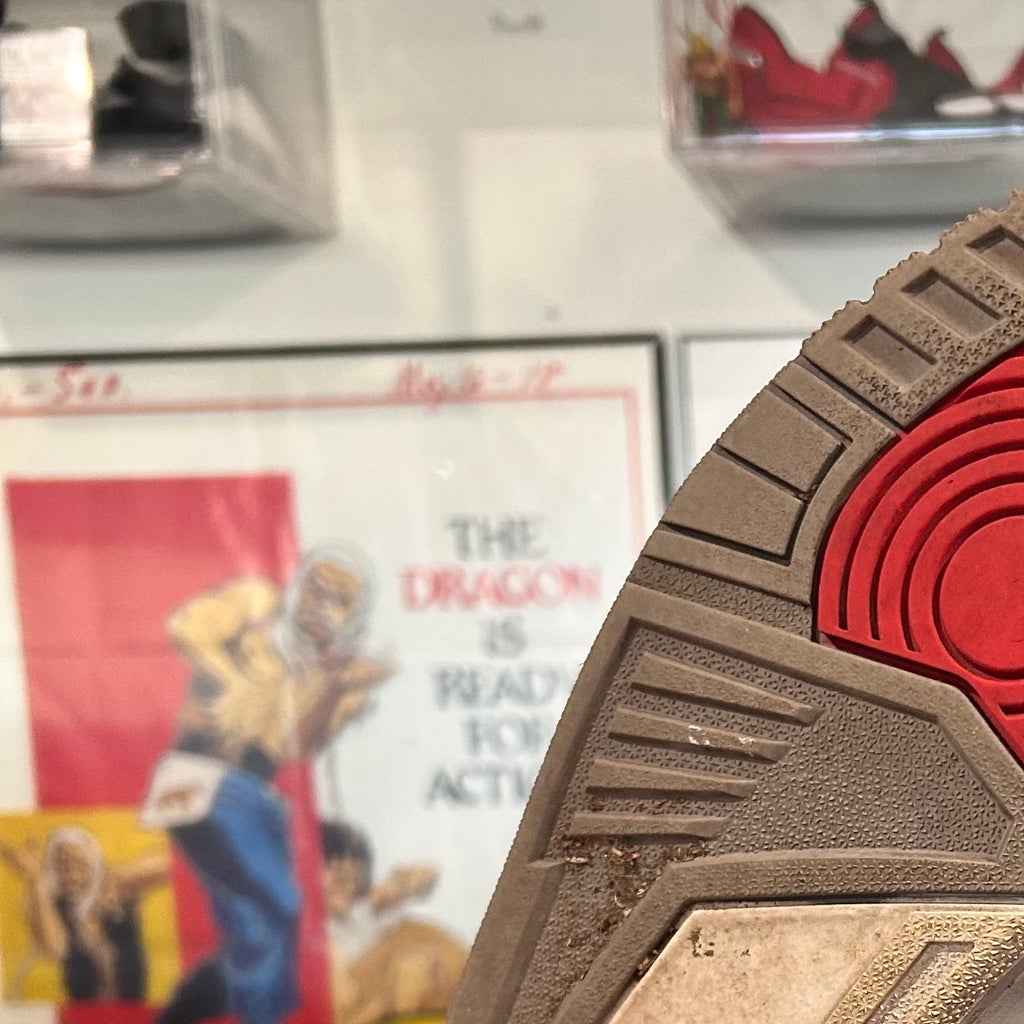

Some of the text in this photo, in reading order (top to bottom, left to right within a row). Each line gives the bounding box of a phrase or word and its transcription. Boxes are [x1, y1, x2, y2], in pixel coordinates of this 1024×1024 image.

[450, 517, 544, 558] THE
[403, 565, 602, 609] DRAGON
[484, 618, 526, 656] IS
